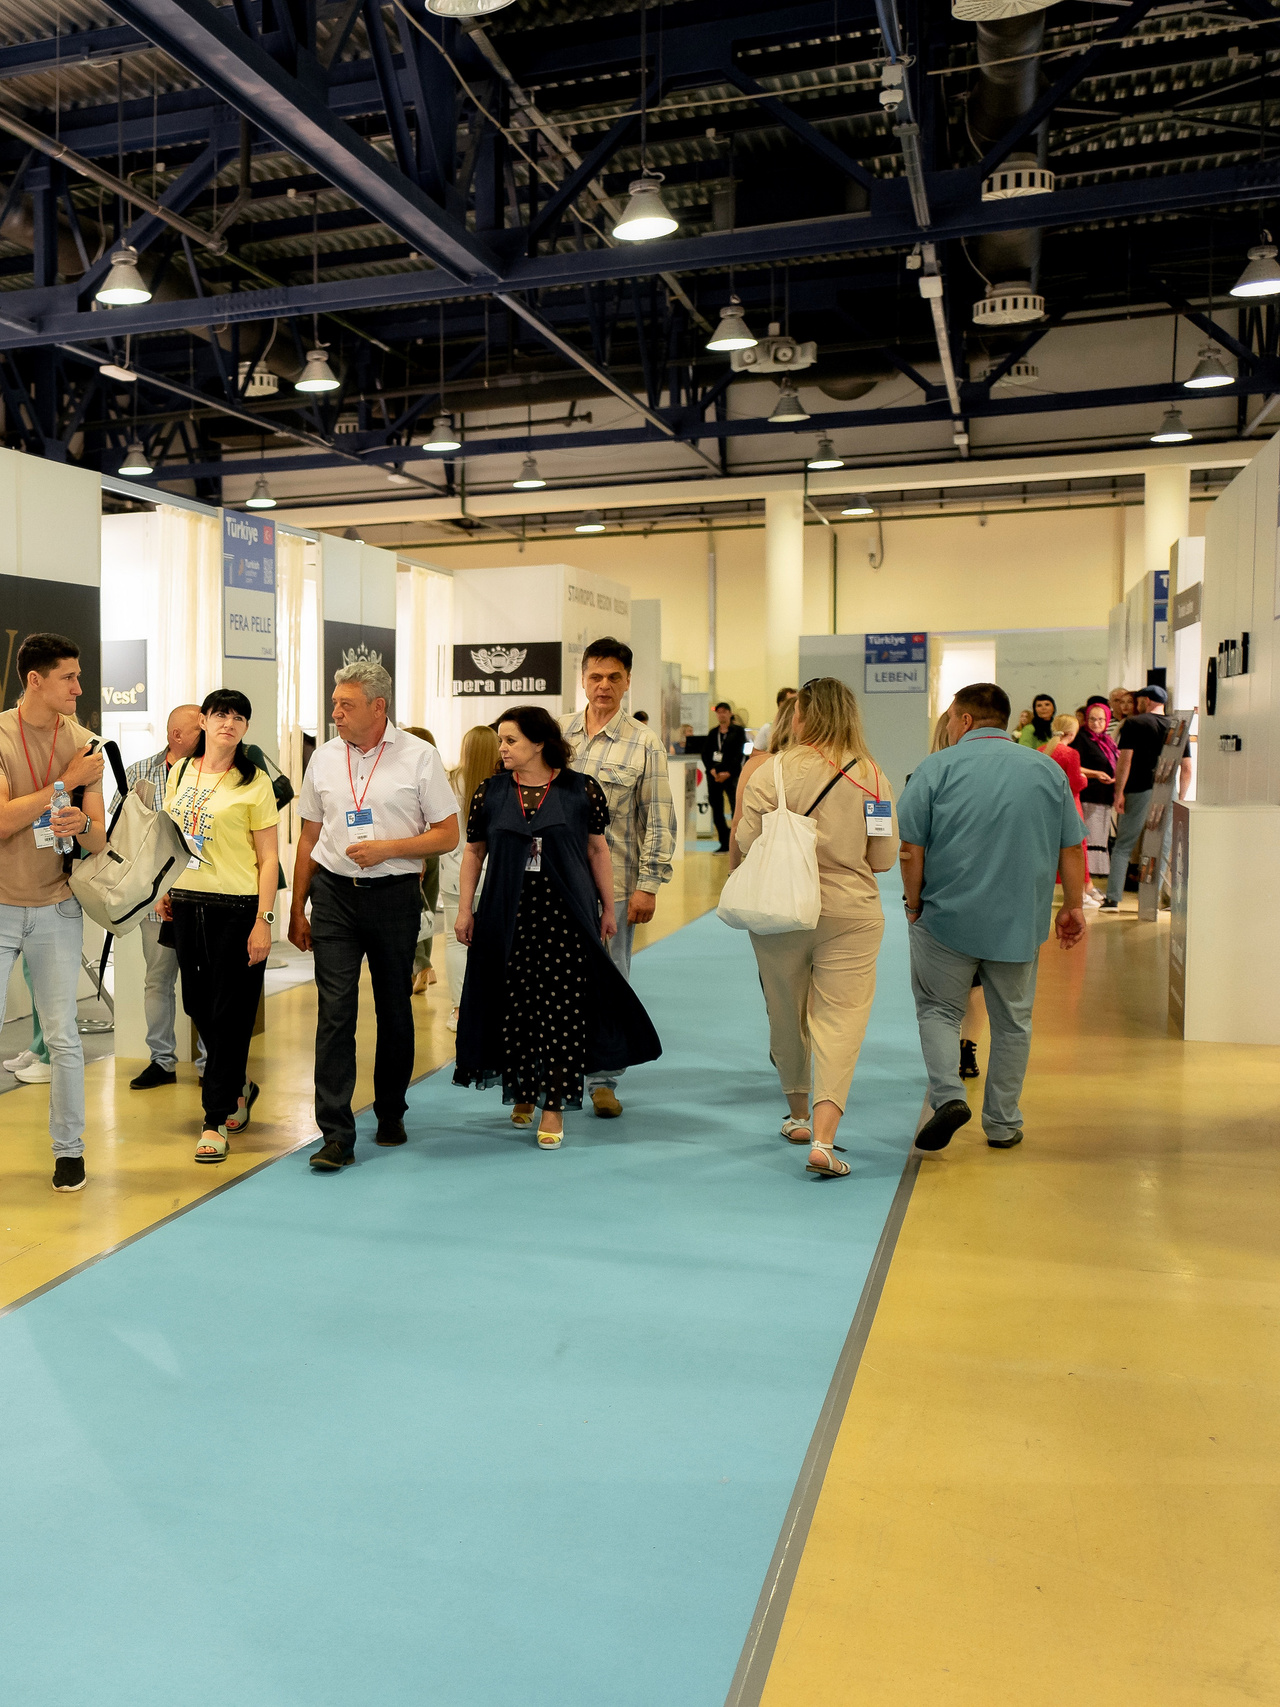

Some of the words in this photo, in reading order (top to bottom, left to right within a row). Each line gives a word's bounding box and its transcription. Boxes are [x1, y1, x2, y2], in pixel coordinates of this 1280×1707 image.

[224, 516, 259, 546] Türkiye
[229, 613, 250, 632] PERA
[251, 615, 272, 634] PELLE
[867, 634, 906, 647] Türkiye
[452, 679, 496, 696] pera
[498, 676, 547, 695] pelle
